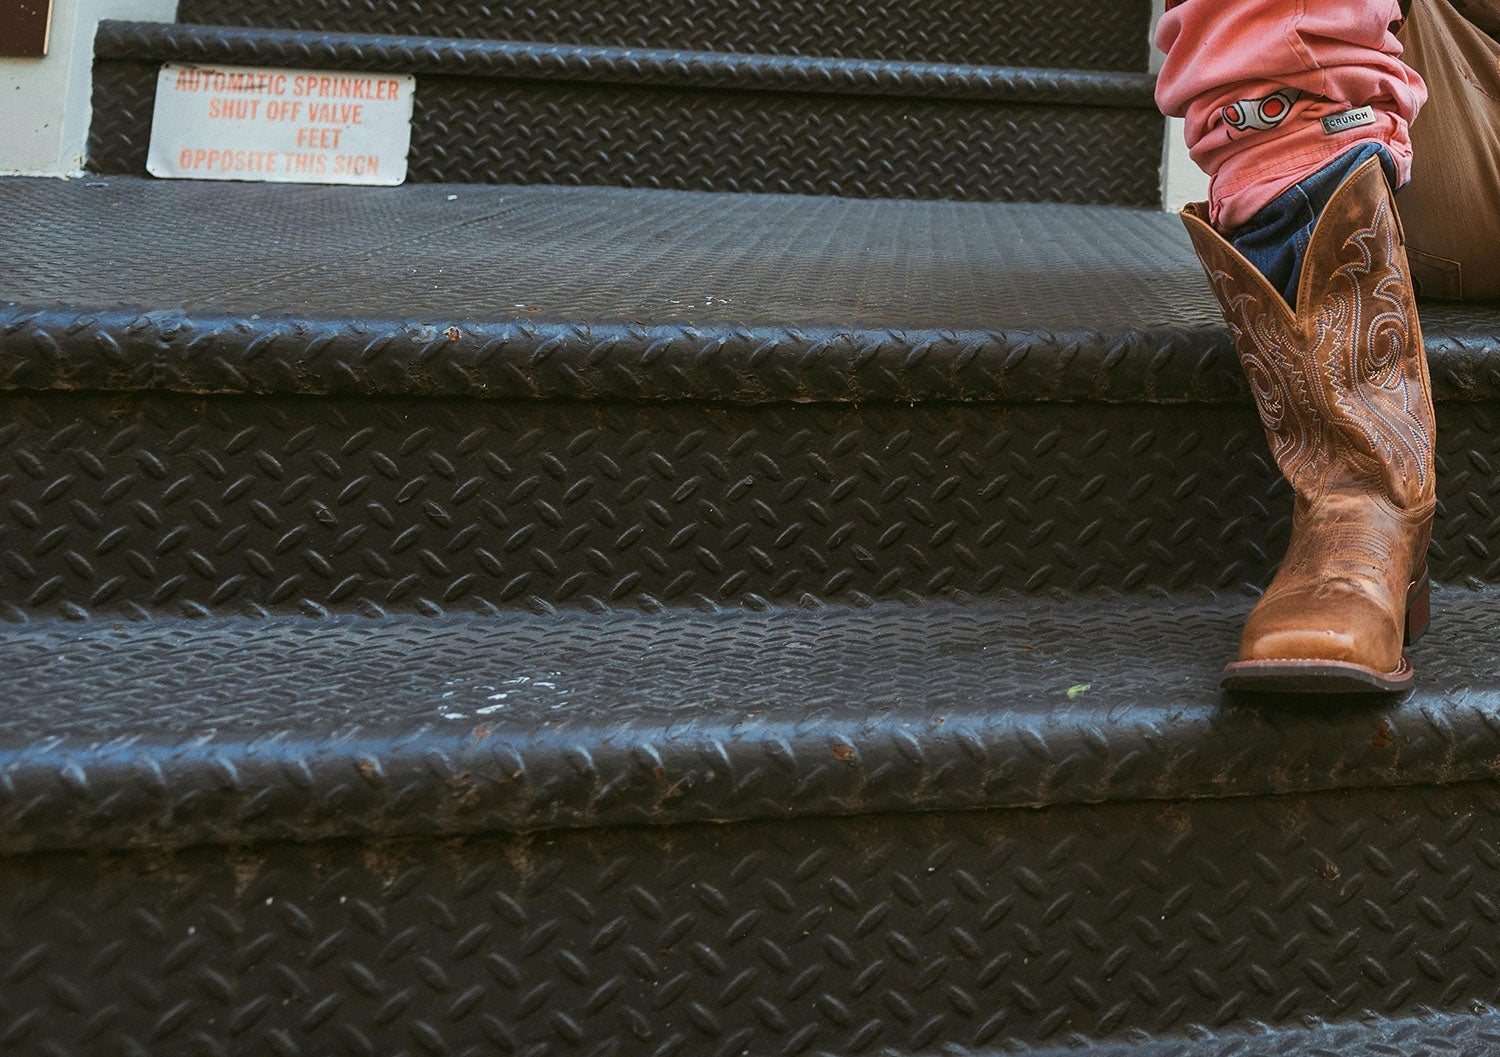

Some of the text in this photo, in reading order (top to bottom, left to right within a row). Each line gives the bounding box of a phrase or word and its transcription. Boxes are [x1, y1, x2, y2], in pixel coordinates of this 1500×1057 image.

[174, 70, 399, 101] AUTOMATIC SPRINKLER
[208, 98, 363, 125] SHUT OFF VALVE
[1329, 112, 1369, 127] CRUNCH
[297, 127, 343, 149] FEET
[178, 149, 379, 176] OPPOSITE THIS SIGN
